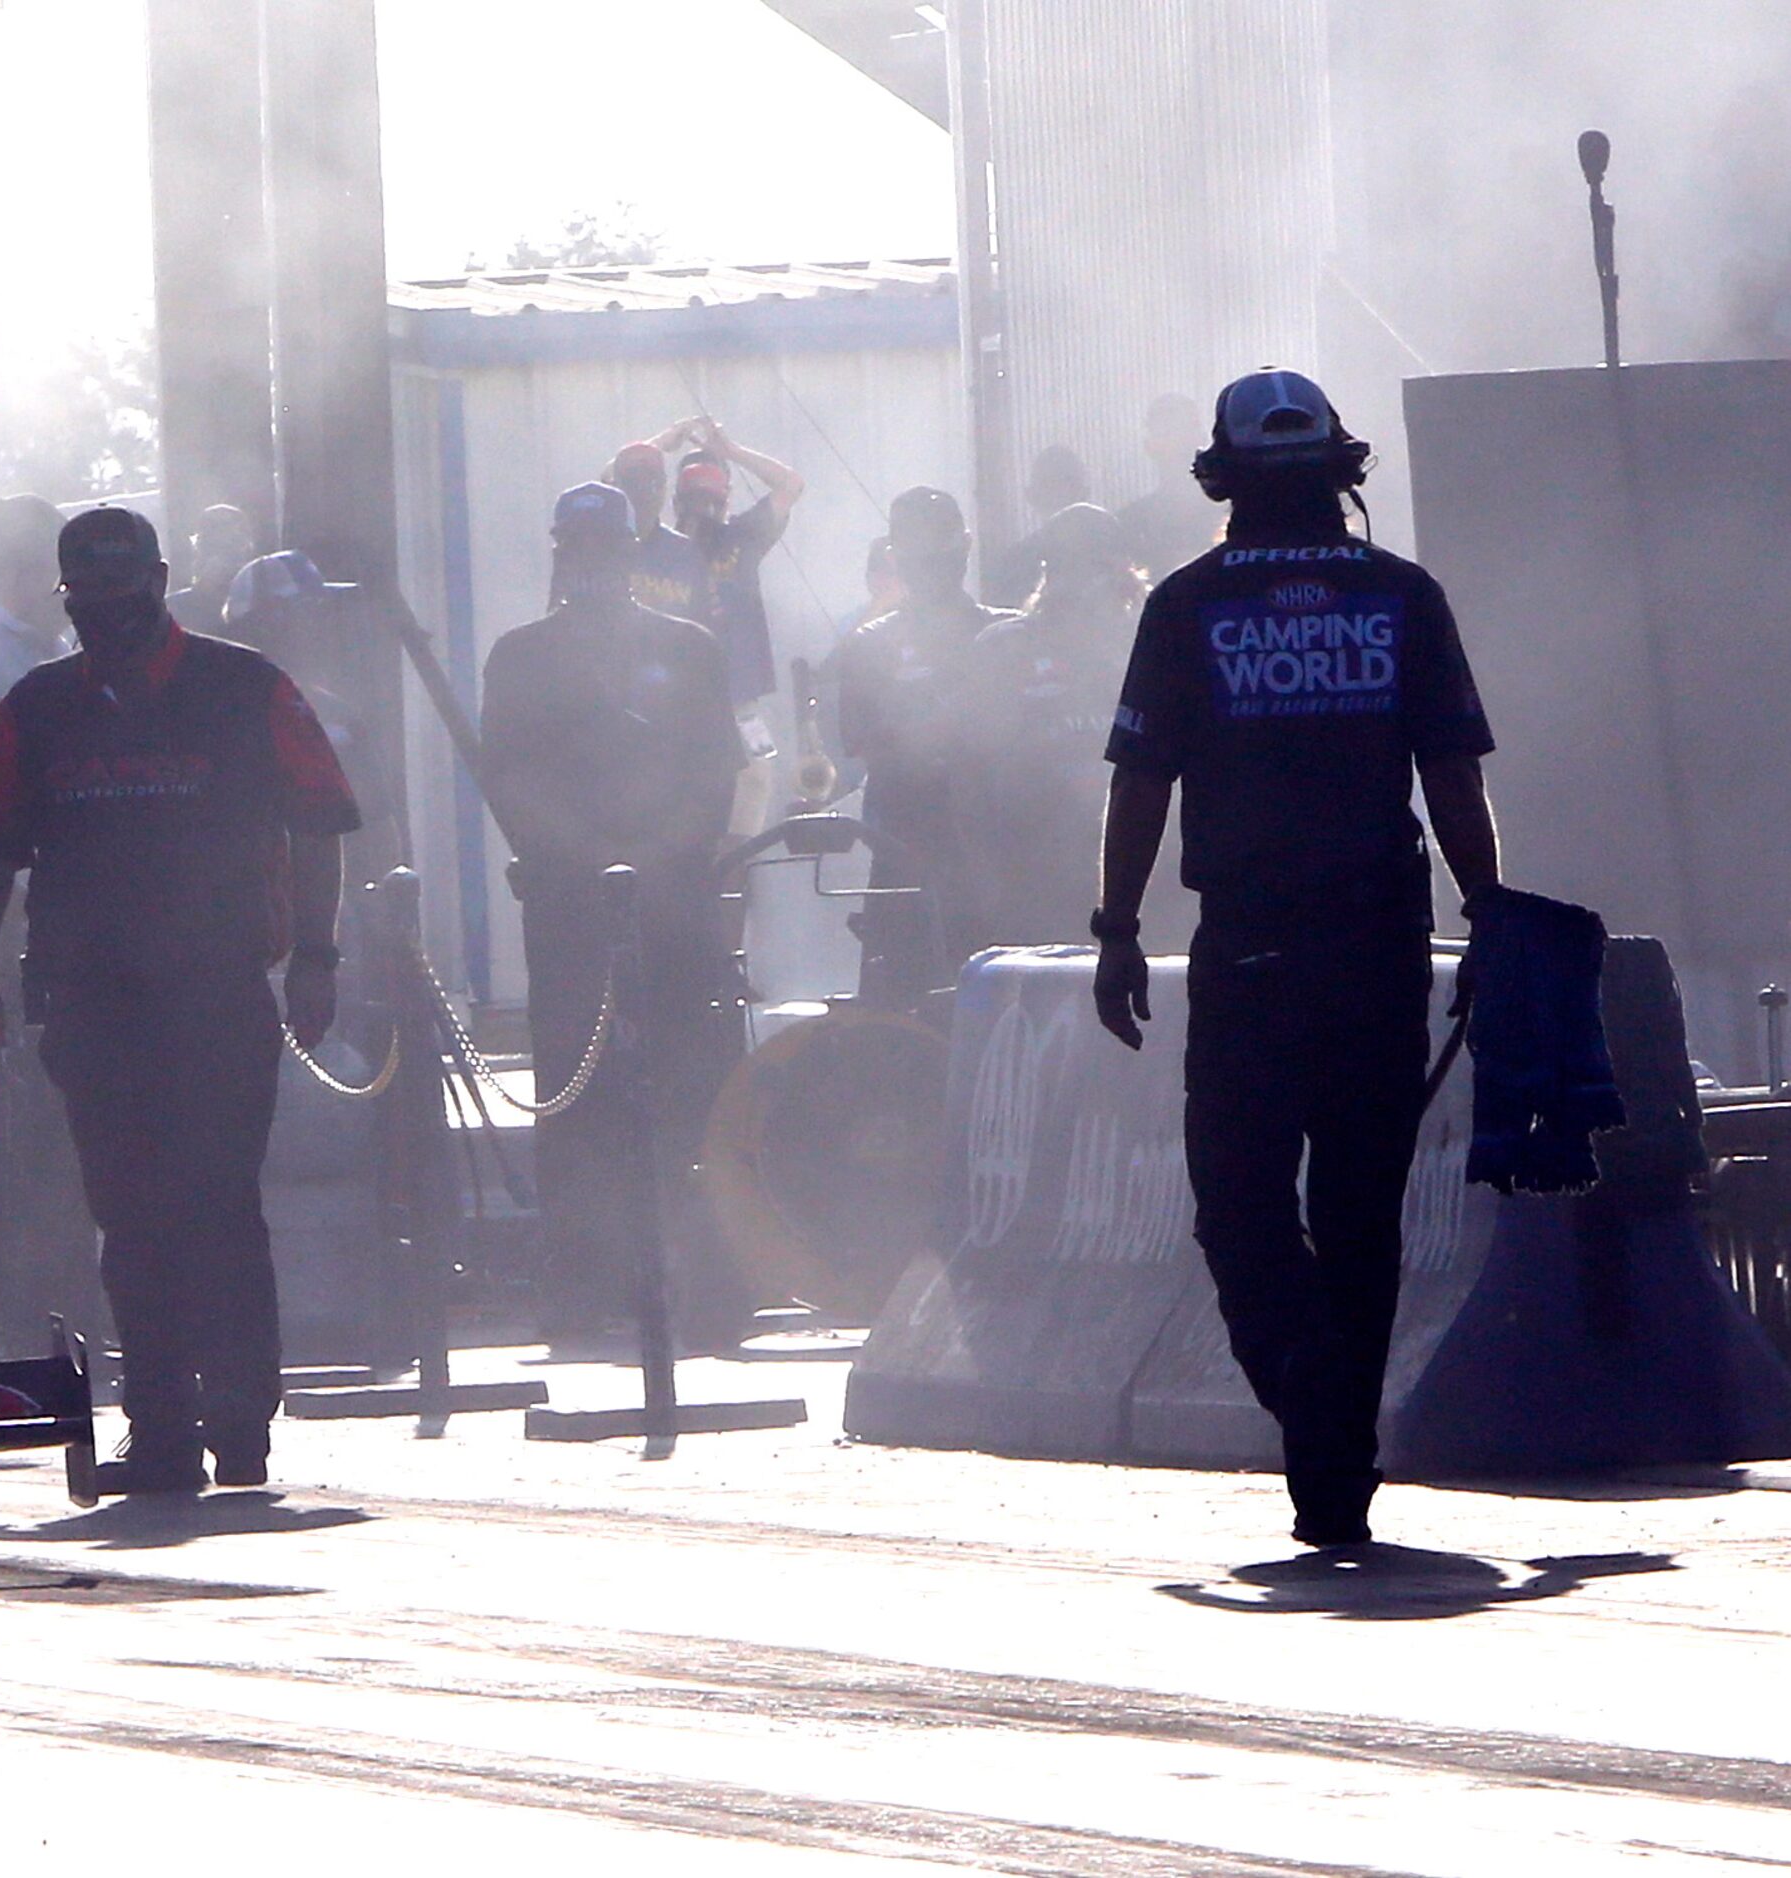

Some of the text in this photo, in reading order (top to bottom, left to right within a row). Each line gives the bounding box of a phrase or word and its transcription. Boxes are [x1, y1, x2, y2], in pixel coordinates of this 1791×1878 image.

[1222, 546, 1372, 567] OFFICIAL
[1272, 584, 1329, 606] NHRA
[1211, 613, 1394, 653] CAMPING
[1216, 648, 1396, 696] WORLD
